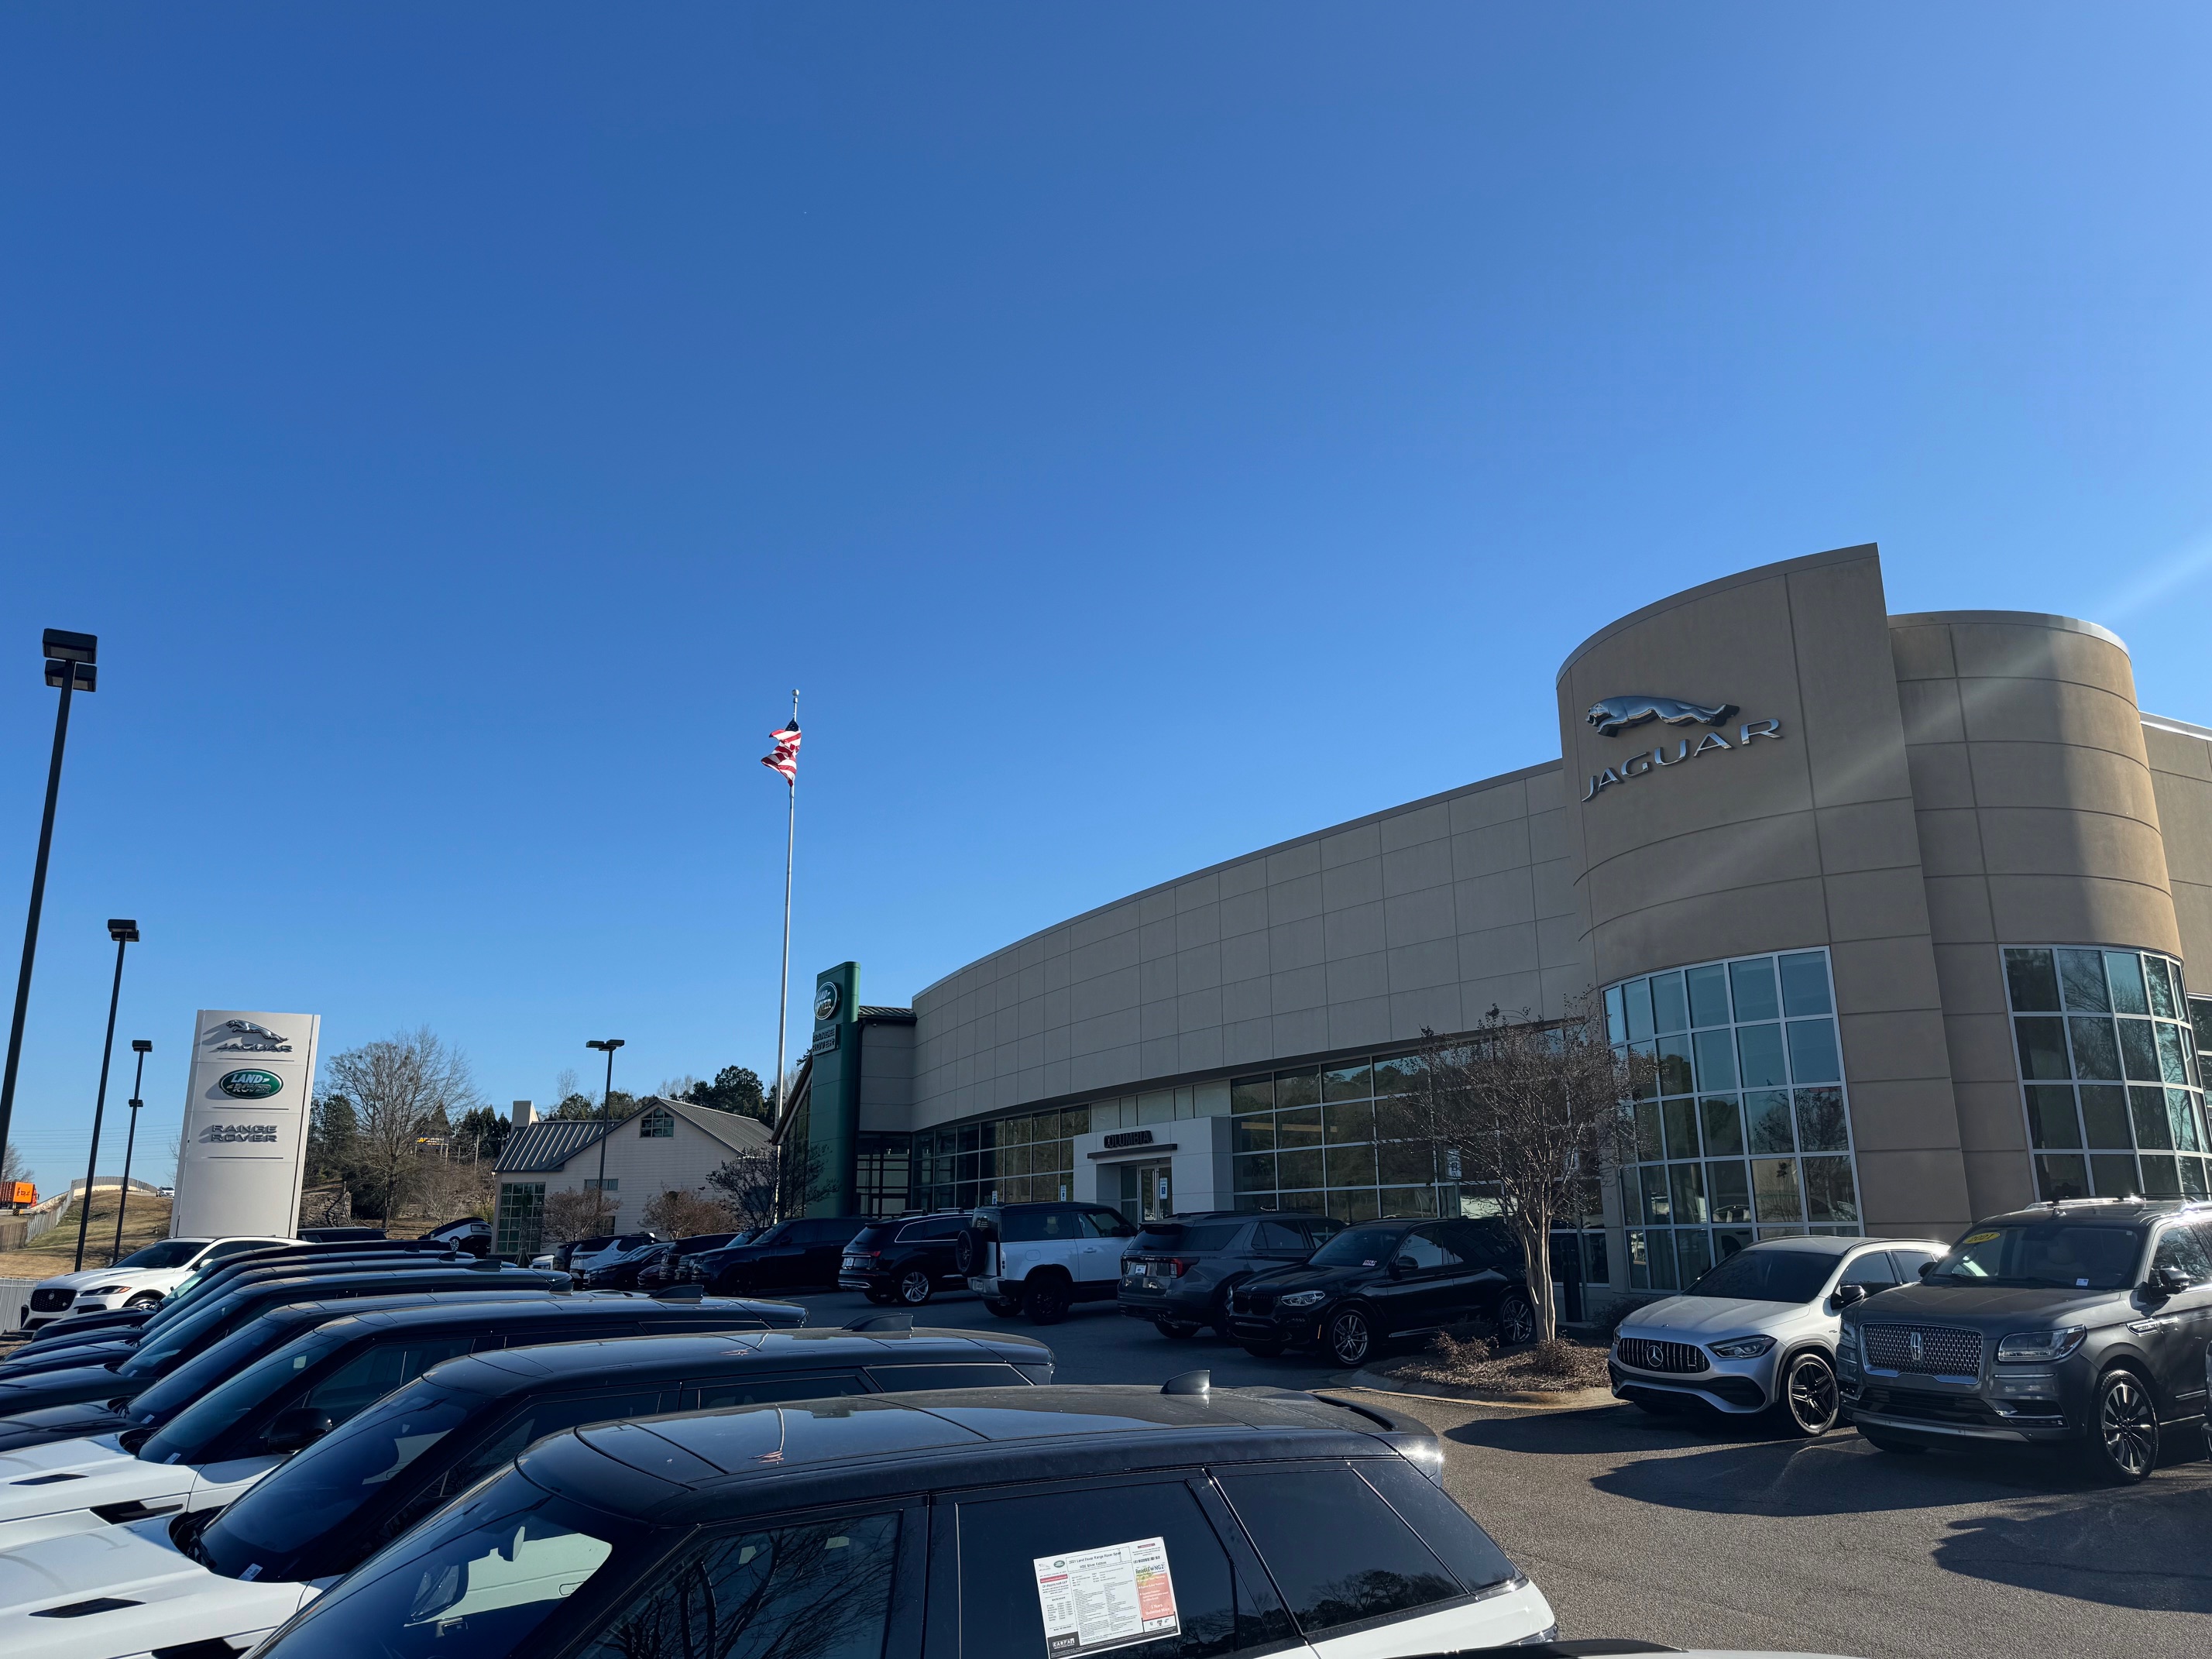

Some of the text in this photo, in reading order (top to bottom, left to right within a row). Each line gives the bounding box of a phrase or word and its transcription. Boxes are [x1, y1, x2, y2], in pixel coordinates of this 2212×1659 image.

[1582, 718, 1781, 802] JAGUAR
[217, 1042, 293, 1053] JAGUAR
[813, 1039, 835, 1052] ROVER
[231, 1073, 263, 1084] LAND
[232, 1084, 272, 1093] ROVER
[212, 1125, 277, 1133] RANGE
[211, 1134, 277, 1142] ROVER
[1104, 1131, 1153, 1148] COLUMBIA
